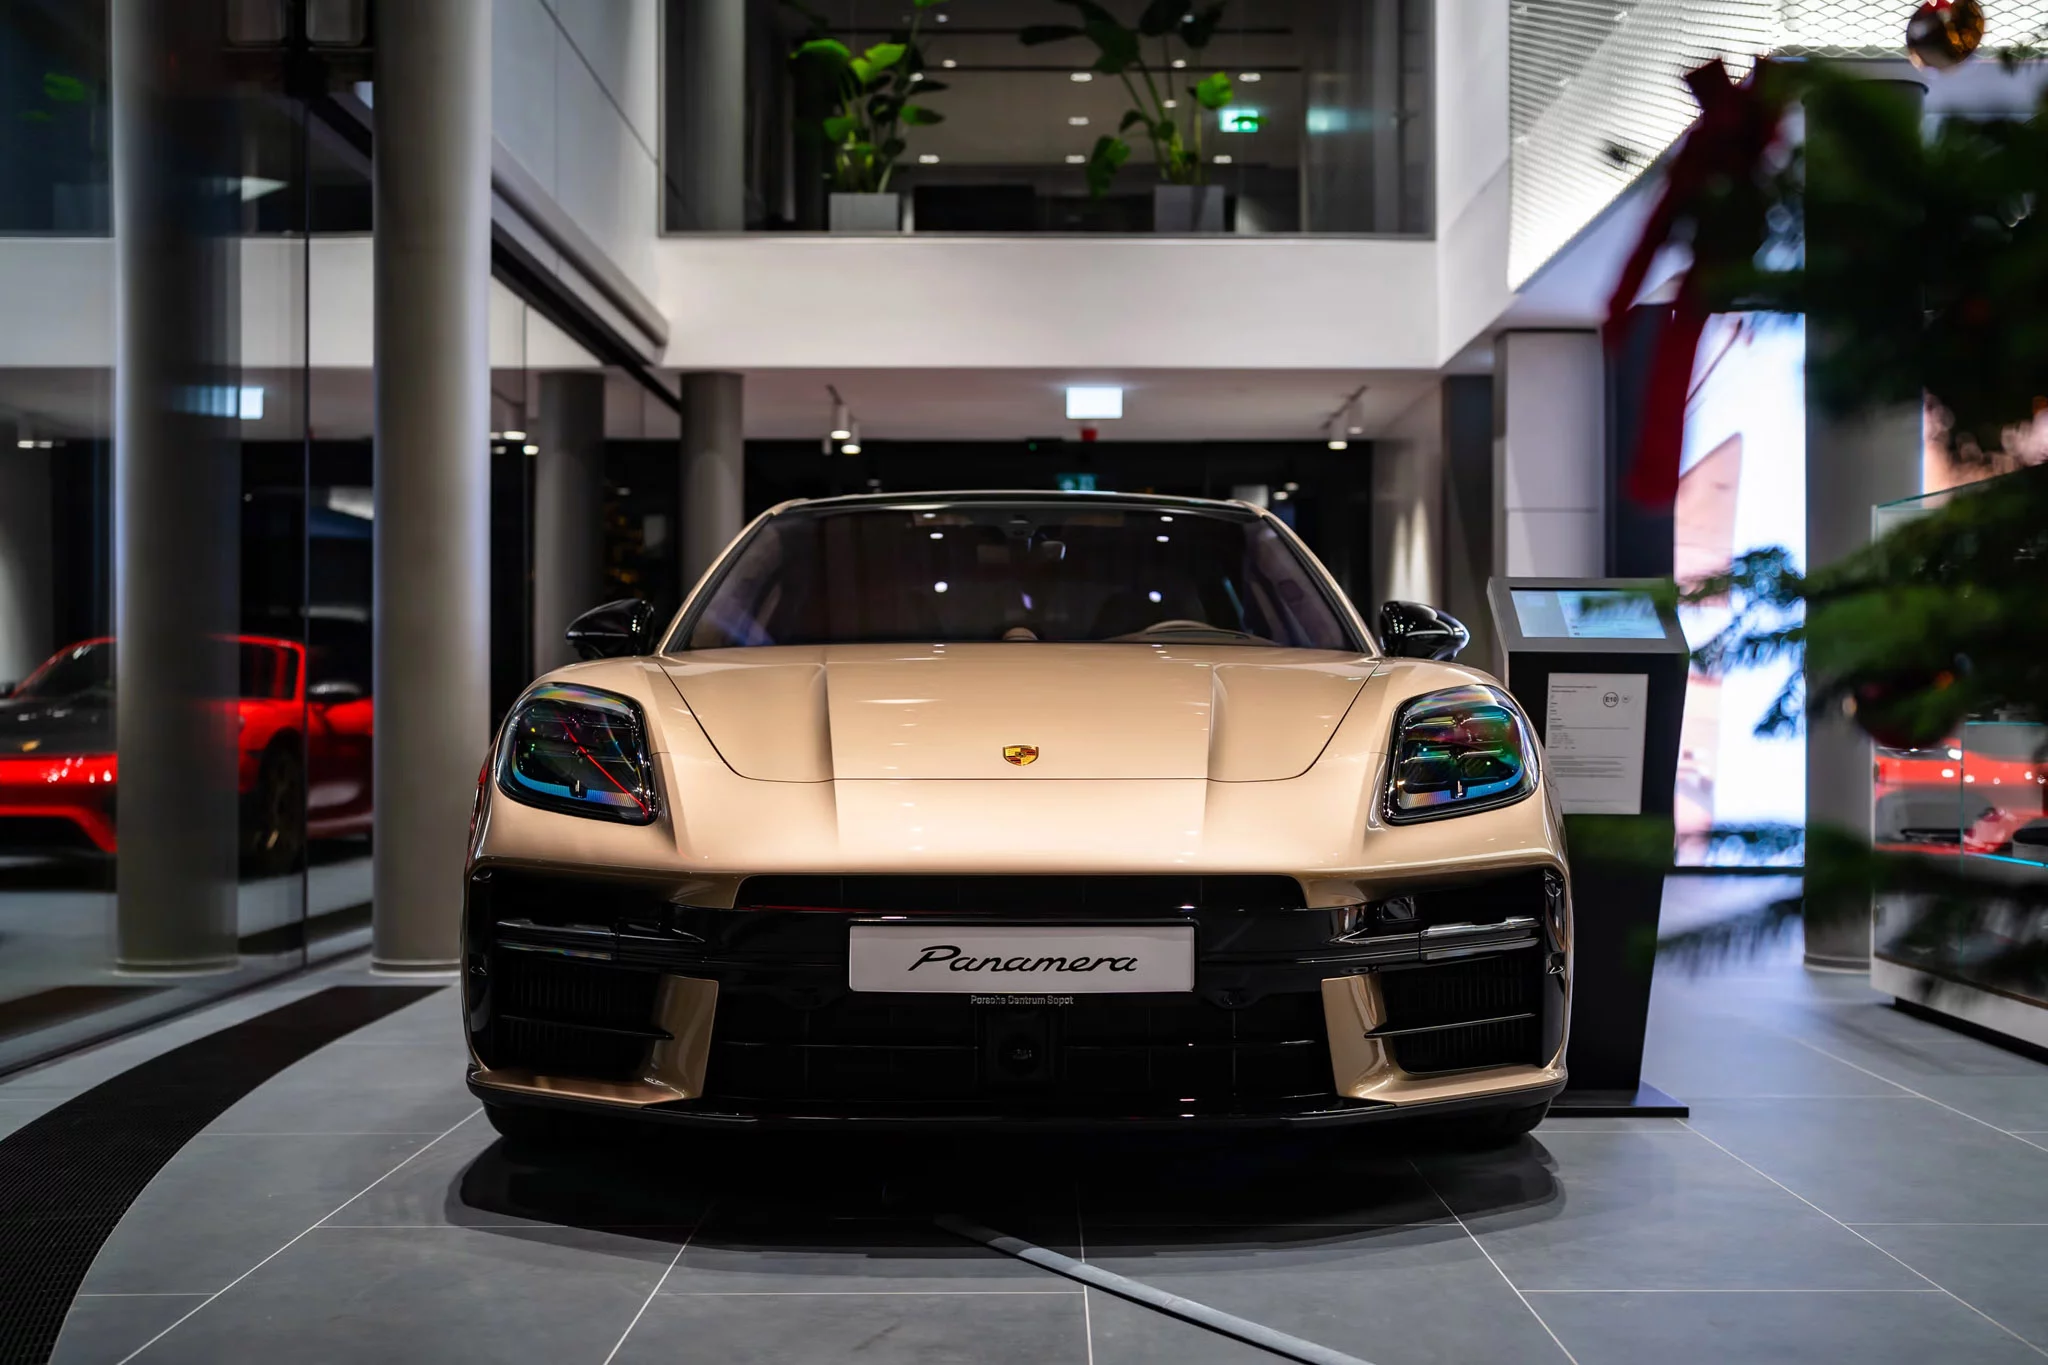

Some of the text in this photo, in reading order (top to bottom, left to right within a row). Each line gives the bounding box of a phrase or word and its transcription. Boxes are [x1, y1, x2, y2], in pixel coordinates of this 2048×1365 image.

[907, 945, 1138, 972] Panamera
[970, 995, 1074, 1007] Porsche Centrum Sopot
